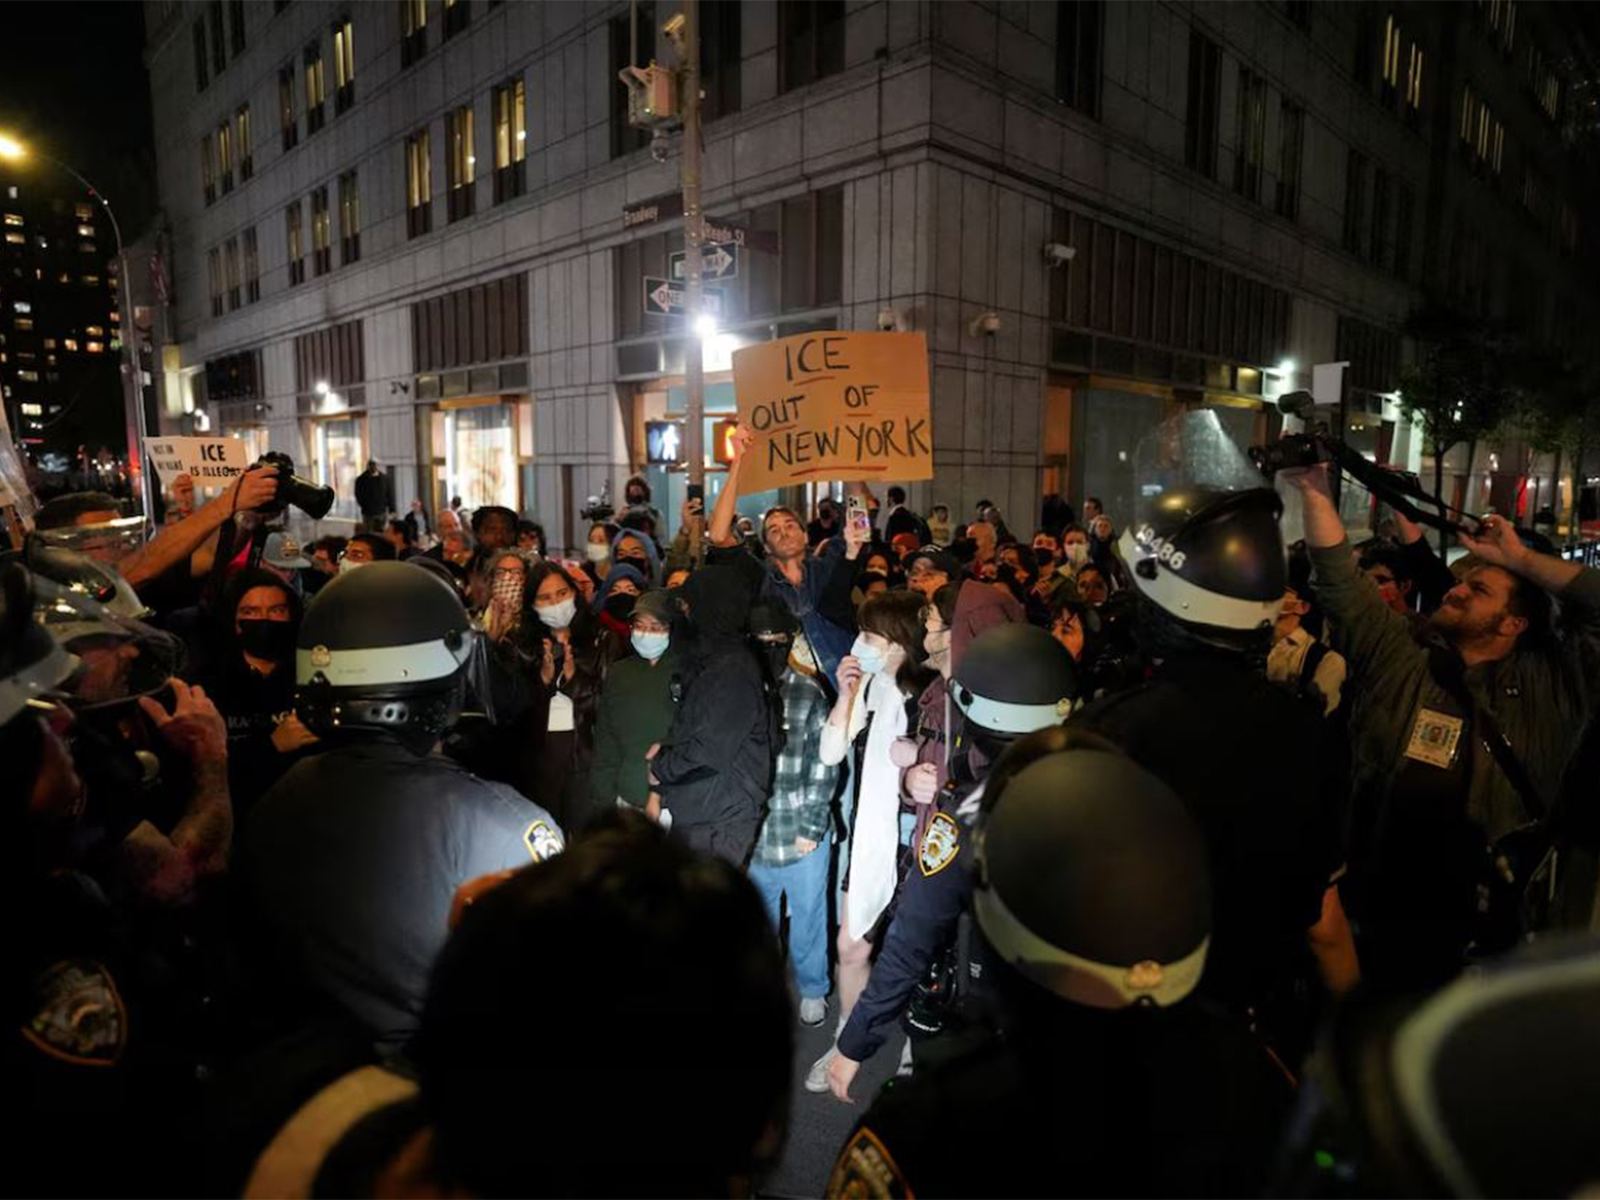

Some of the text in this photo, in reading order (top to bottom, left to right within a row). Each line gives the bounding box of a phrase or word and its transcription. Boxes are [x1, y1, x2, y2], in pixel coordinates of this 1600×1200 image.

[657, 290, 681, 304] ONE
[785, 336, 849, 381] ICE
[751, 385, 881, 430] OUT OF
[200, 444, 226, 462] ICE
[768, 417, 929, 471] NEW YORK
[190, 466, 200, 477] IS
